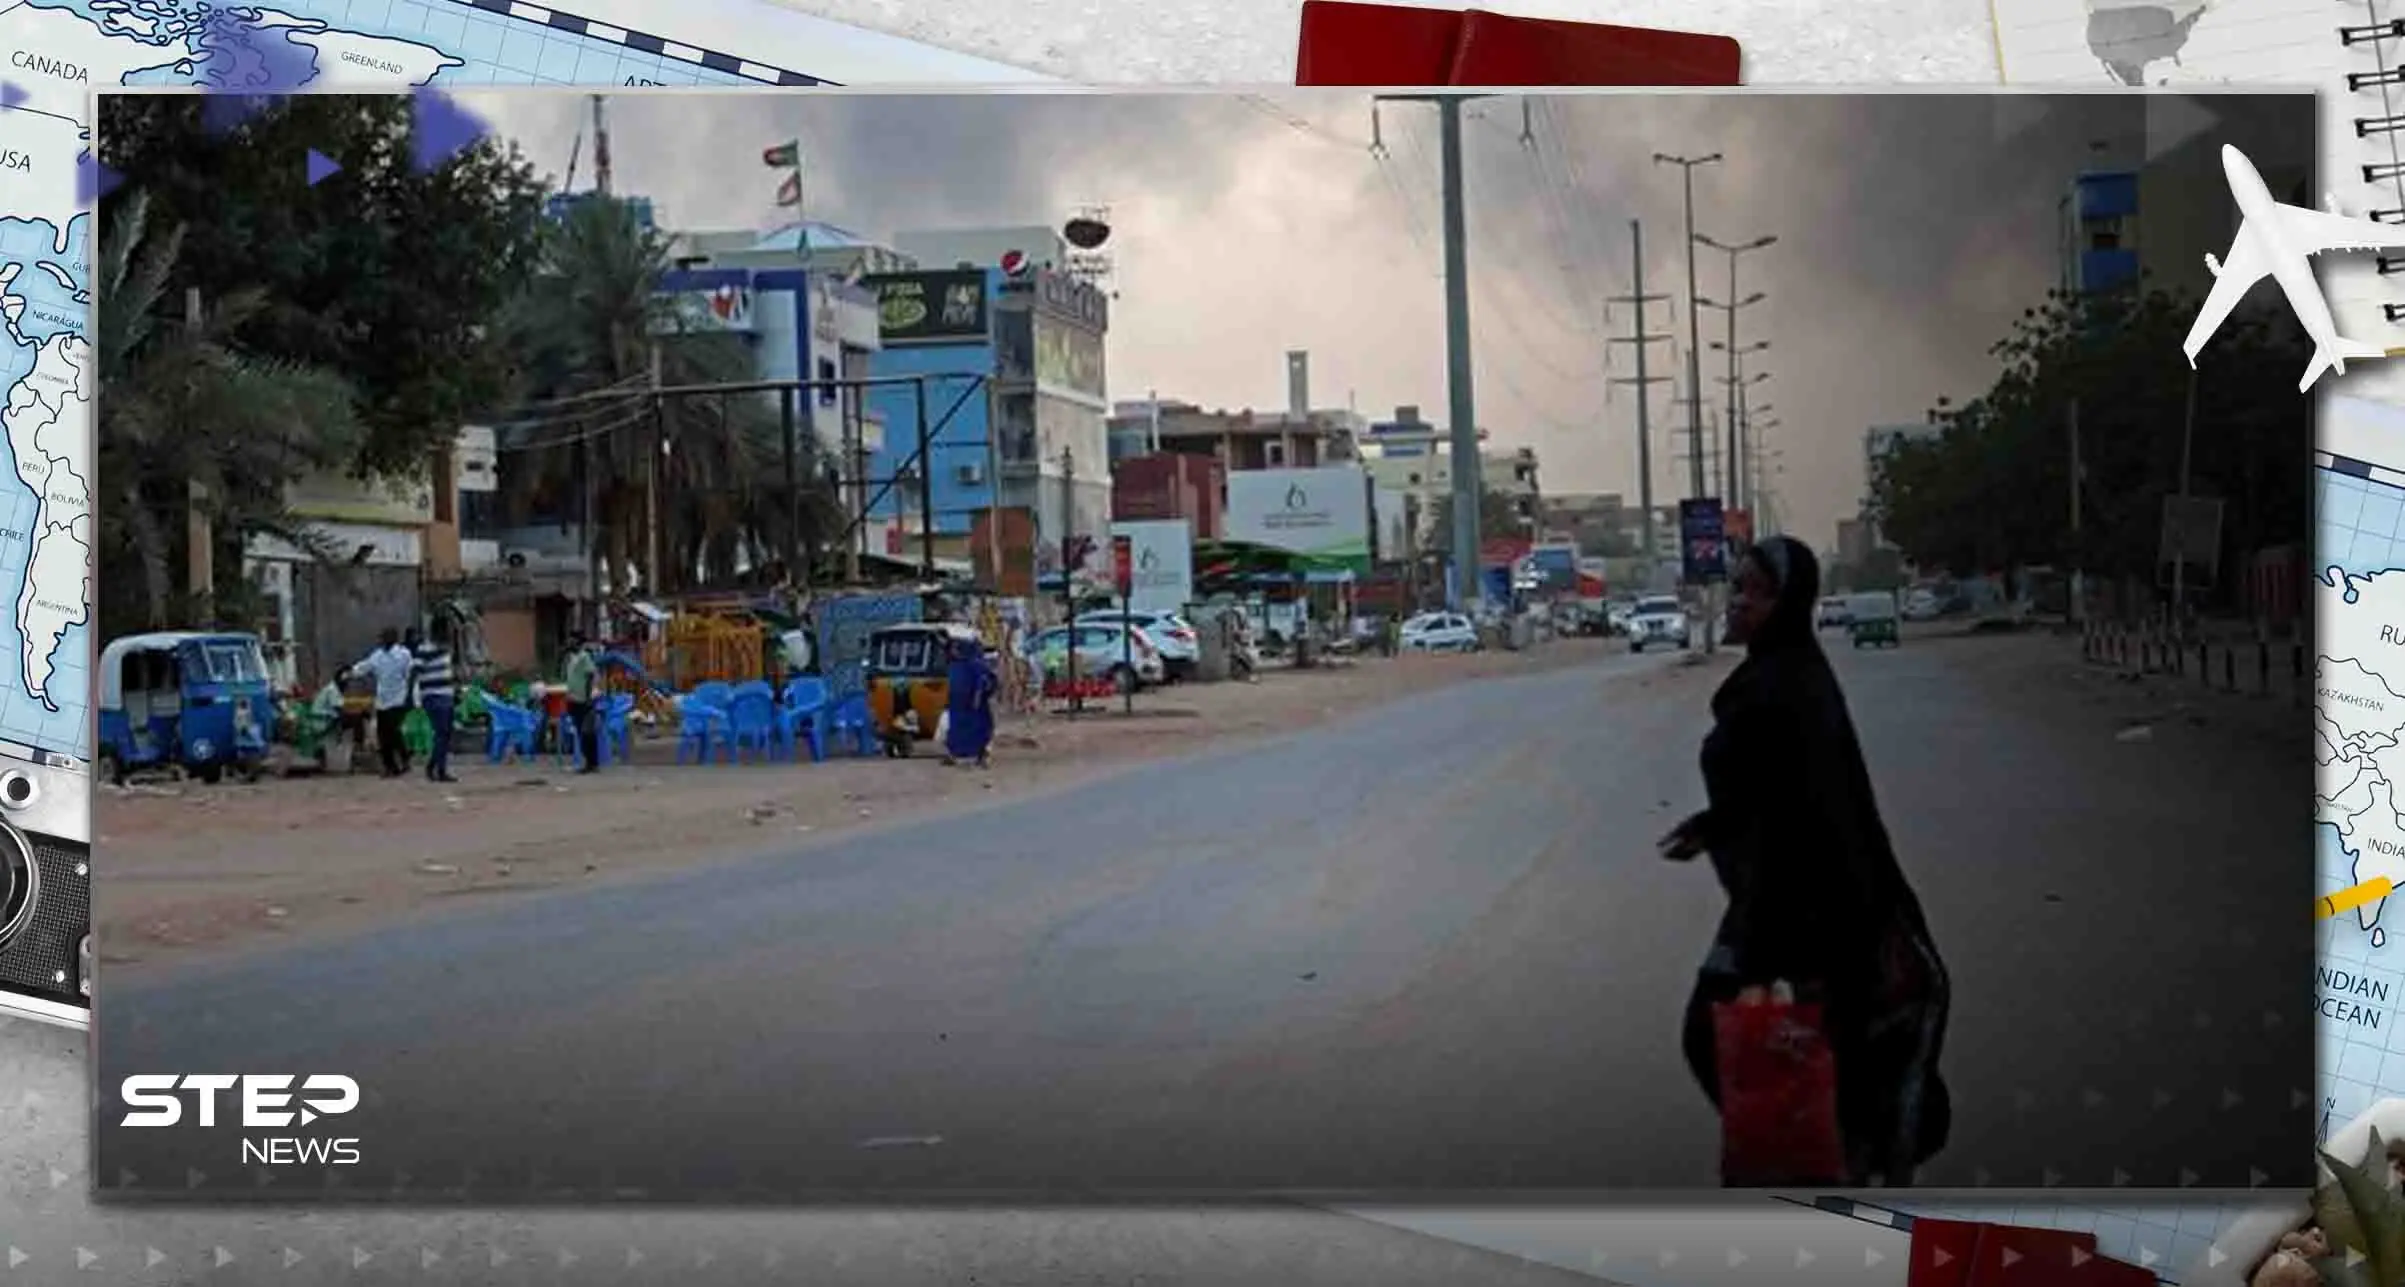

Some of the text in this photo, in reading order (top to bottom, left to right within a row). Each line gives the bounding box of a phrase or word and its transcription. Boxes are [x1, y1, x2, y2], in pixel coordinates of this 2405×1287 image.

[11, 50, 89, 86] CANADA
[340, 51, 403, 75] GREENLAND
[32, 310, 84, 330] NICARAGUA
[22, 462, 45, 474] PERU
[51, 492, 85, 507] BOLIVIA
[35, 599, 79, 617] ARGENTINA
[2317, 687, 2385, 712] KAZAKHSTAN
